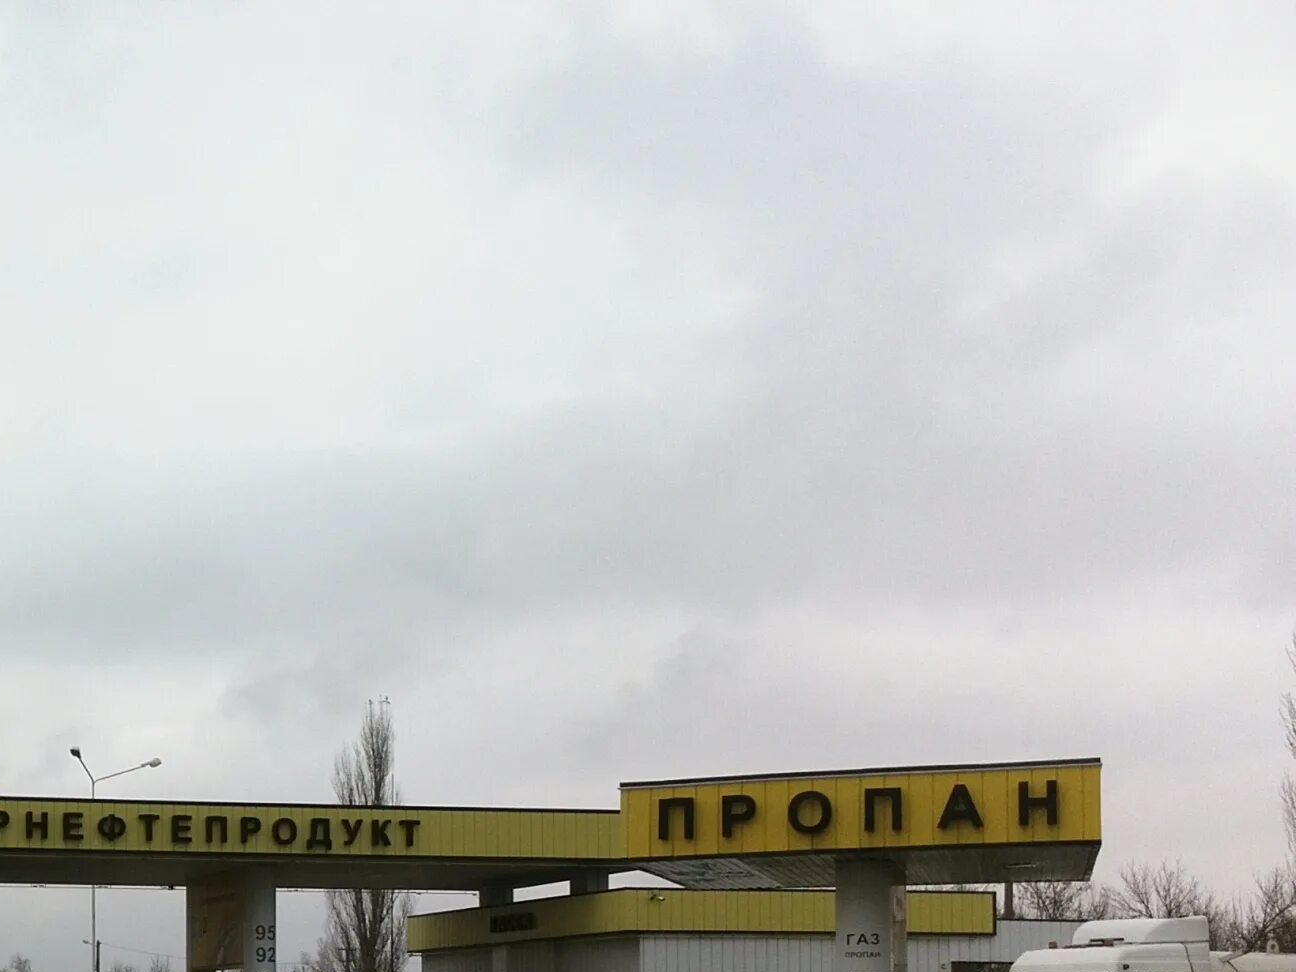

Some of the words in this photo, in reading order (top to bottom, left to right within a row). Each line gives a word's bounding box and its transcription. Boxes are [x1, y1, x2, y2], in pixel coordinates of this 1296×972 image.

[658, 779, 1060, 841] ПРОПАН
[256, 925, 275, 941] 95
[846, 933, 880, 945] ГАЗ
[256, 947, 275, 963] 92
